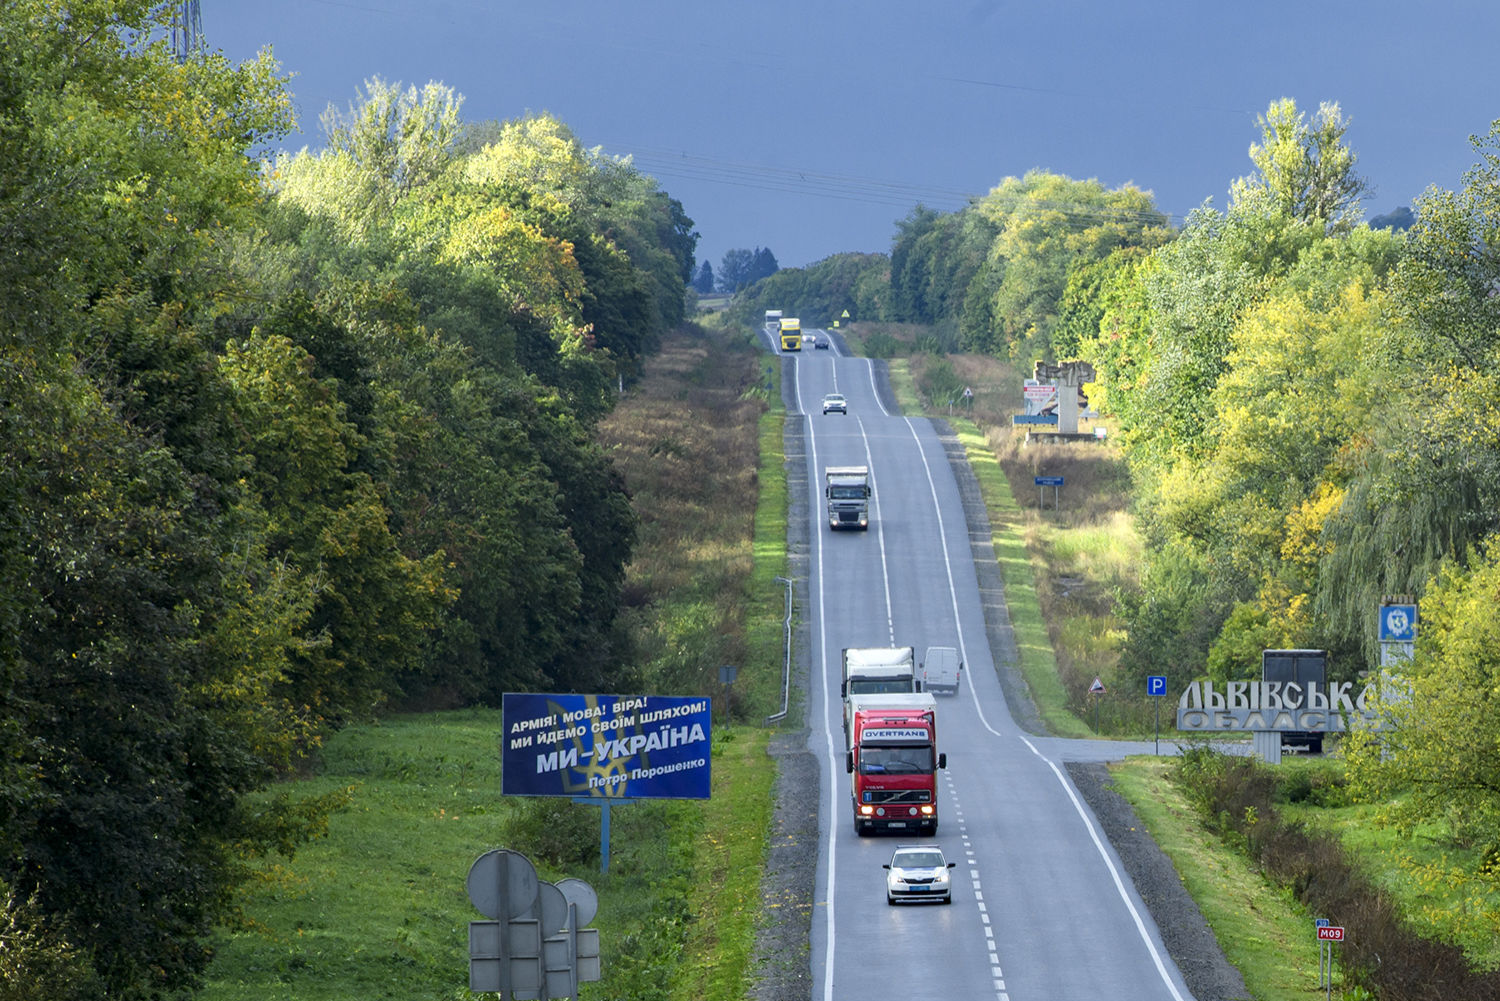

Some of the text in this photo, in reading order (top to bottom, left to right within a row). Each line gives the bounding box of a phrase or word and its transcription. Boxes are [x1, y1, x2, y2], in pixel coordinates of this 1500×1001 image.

[1152, 679, 1163, 693] P
[510, 697, 648, 734] АРМІЯ! МОВА! ВІРА!
[510, 701, 706, 750] МИ ЙДЕМО СВОЇМ ШЛЯХОМ!
[589, 758, 706, 788] Петро Порошенко
